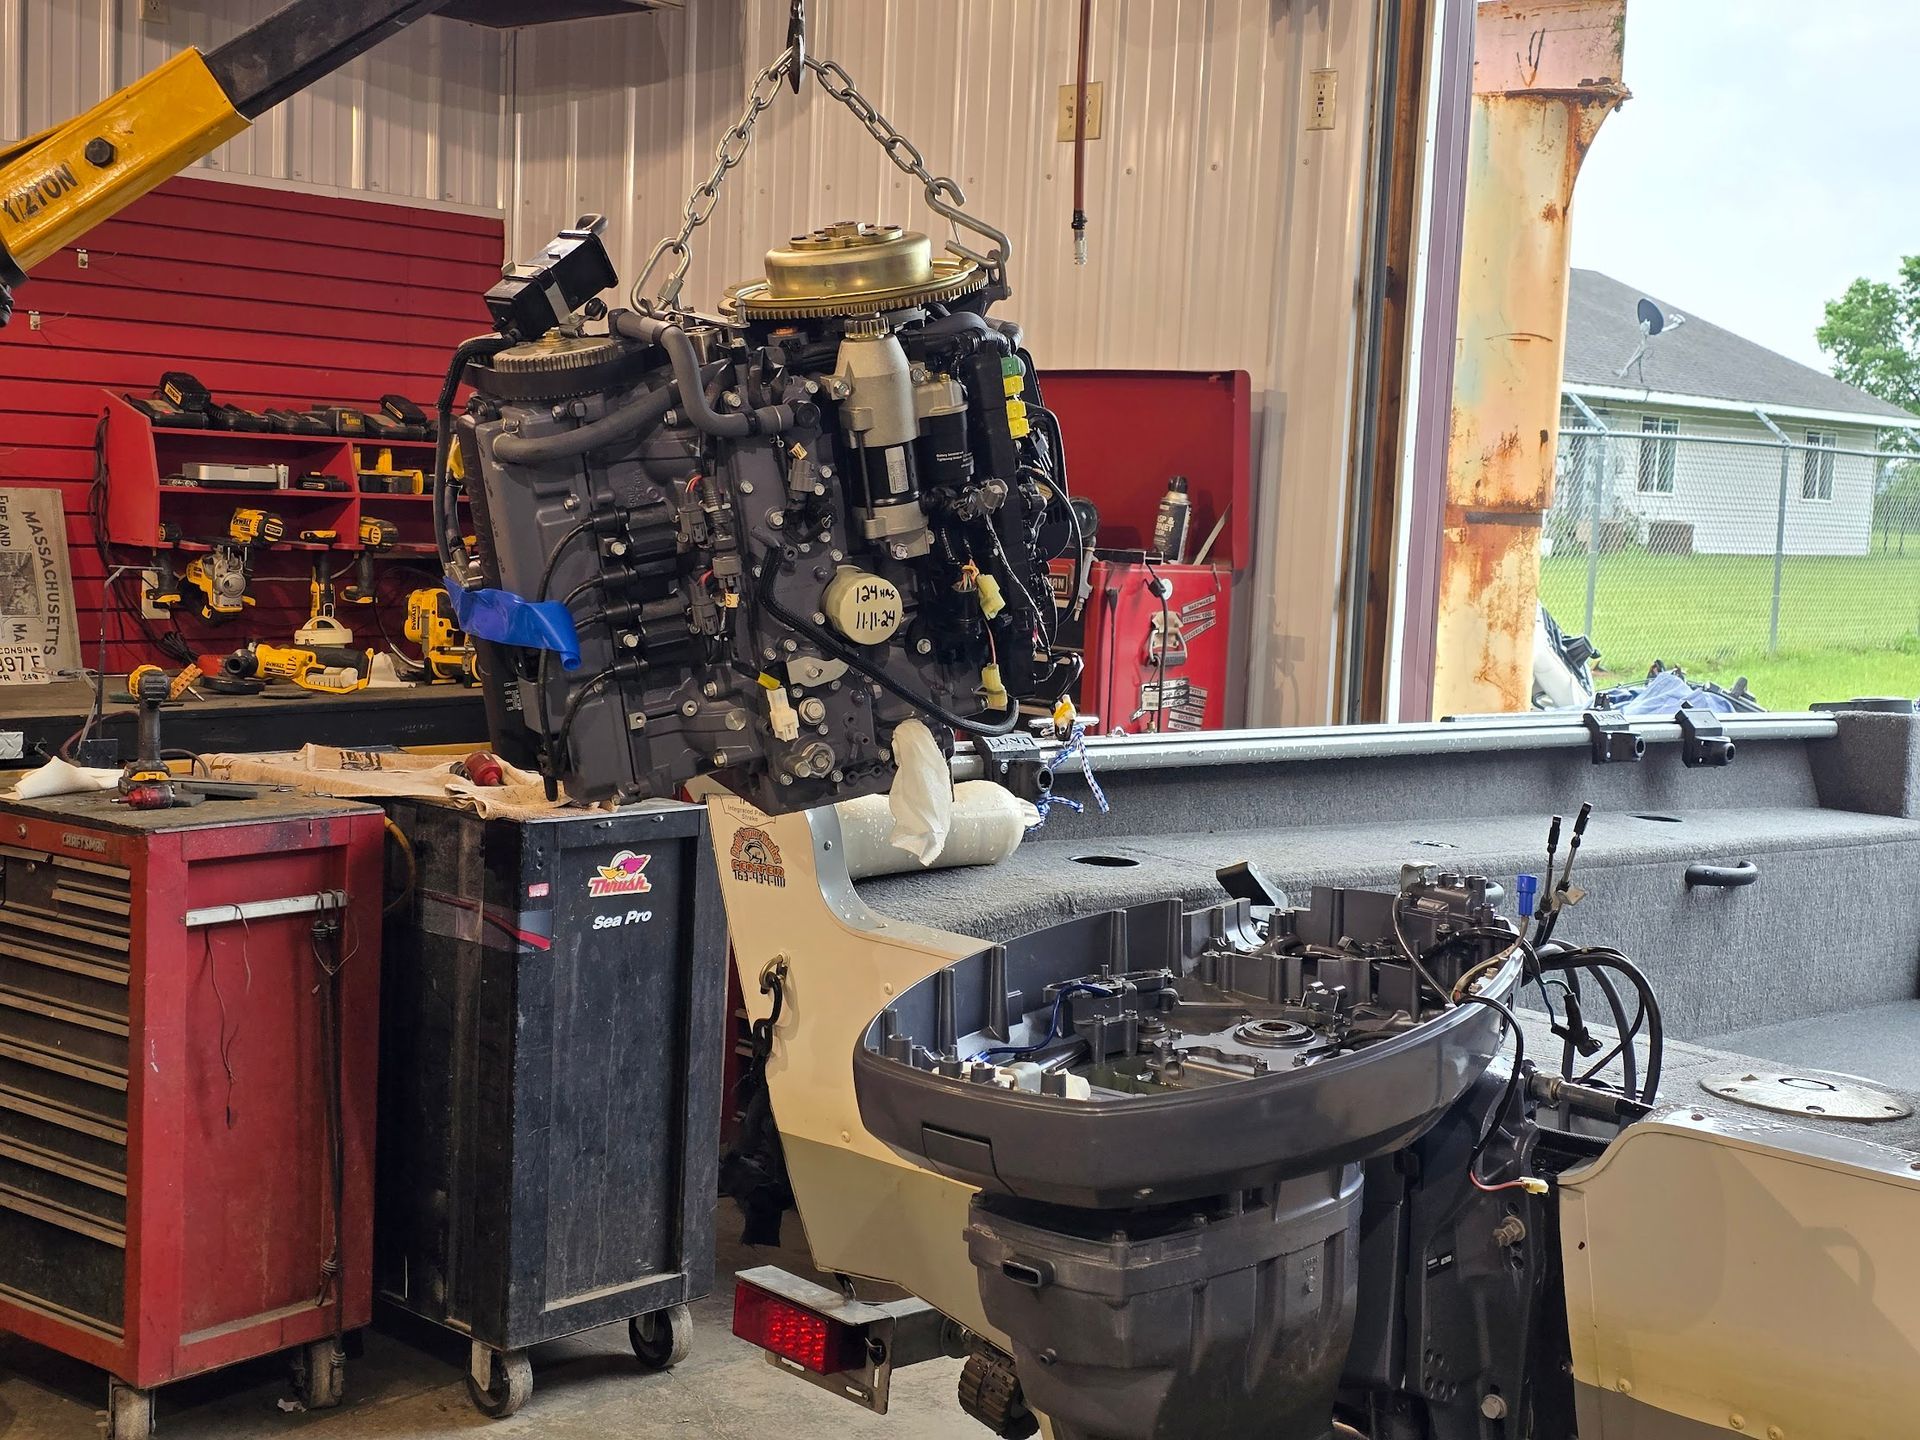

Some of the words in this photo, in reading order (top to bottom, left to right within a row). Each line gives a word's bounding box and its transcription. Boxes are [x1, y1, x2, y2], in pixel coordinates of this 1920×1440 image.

[0, 524, 11, 547] AND
[22, 511, 60, 655] MASSACHUSETTS
[856, 585, 878, 603] 124
[880, 588, 895, 600] HRS
[731, 859, 784, 877] CENTER
[590, 876, 649, 896] Thrush
[593, 915, 623, 930] Sea
[625, 910, 653, 925] Pro
